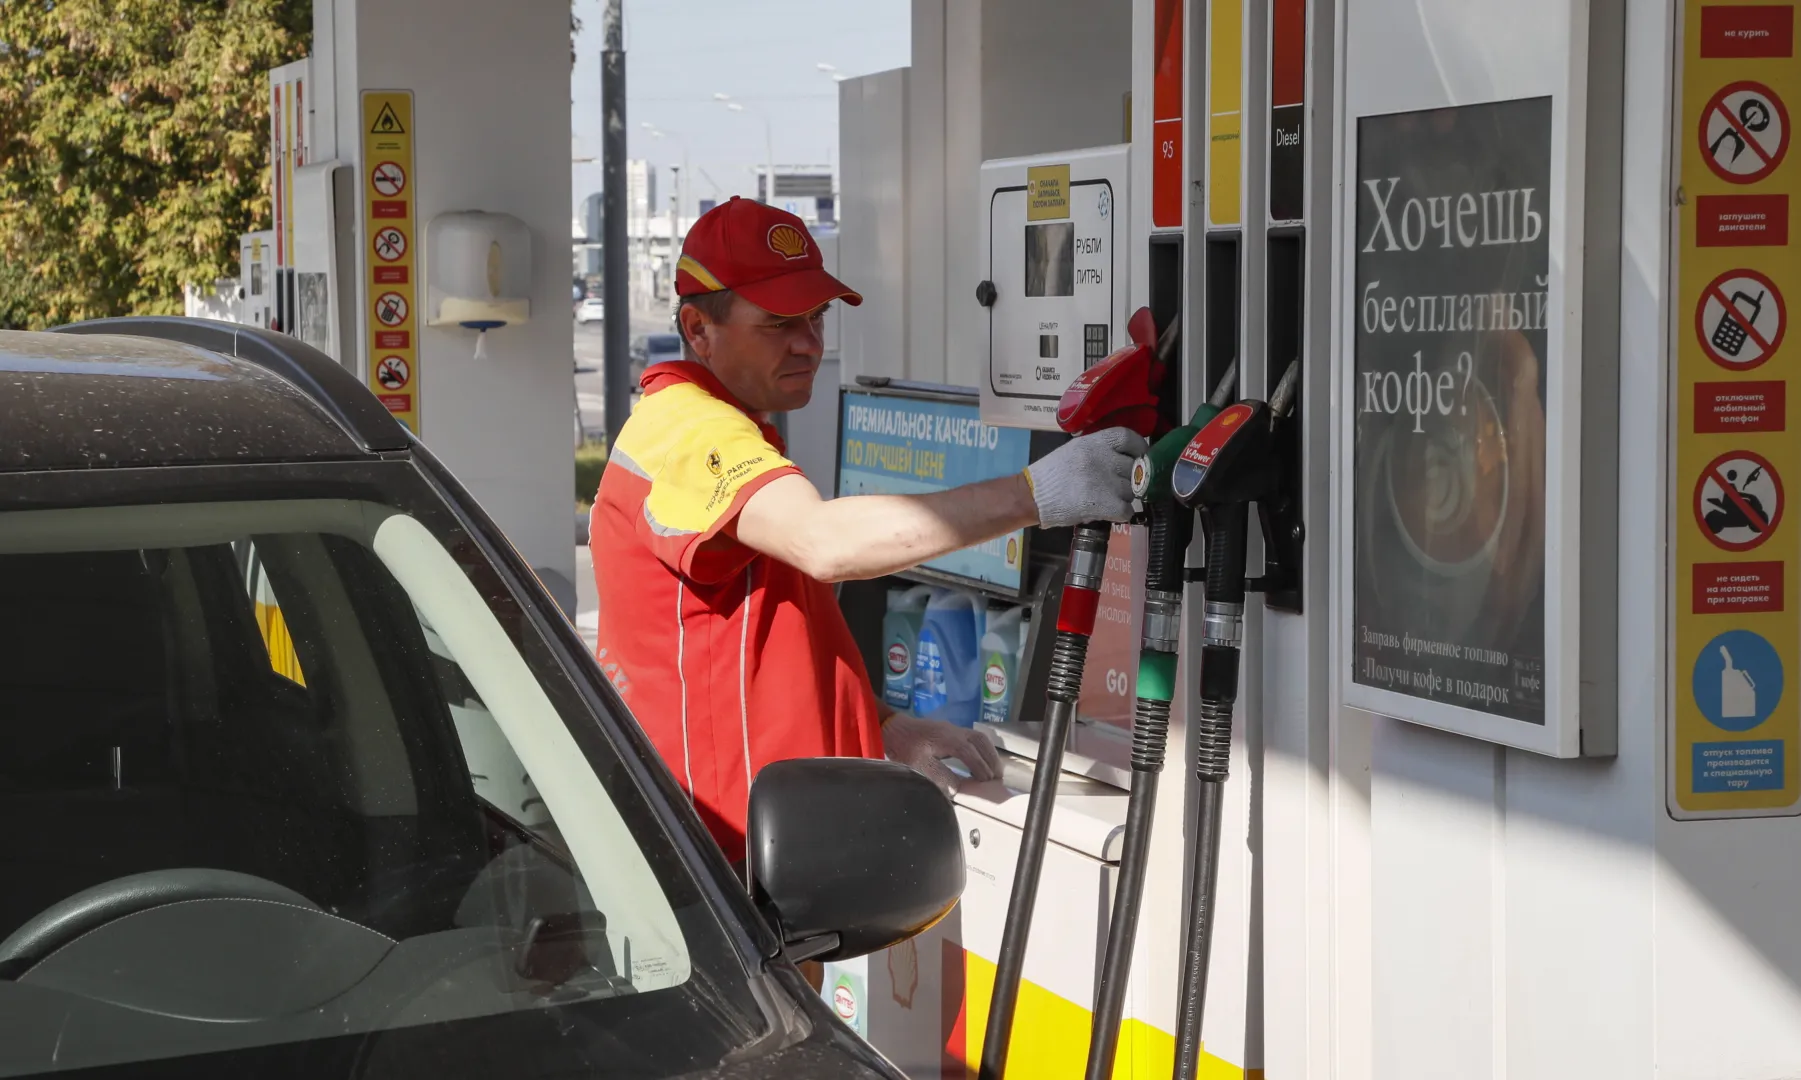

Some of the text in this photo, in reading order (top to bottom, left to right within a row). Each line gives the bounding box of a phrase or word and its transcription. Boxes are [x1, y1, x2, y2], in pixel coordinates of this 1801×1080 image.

[1738, 30, 1770, 39] курить
[1276, 124, 1300, 147] Diesel
[1162, 140, 1174, 159] 95
[1362, 177, 1543, 253] Хочешь
[1719, 213, 1767, 223] заглушите
[1718, 224, 1766, 232] двигатели
[1076, 238, 1102, 254] РУБЛИ
[1076, 269, 1103, 285] ЛИТРЫ
[1363, 275, 1549, 334] бесплатный
[1362, 350, 1473, 433] кофе?
[1715, 394, 1764, 402] отключите
[1713, 403, 1766, 413] мобильный
[1720, 414, 1759, 424] телефон
[848, 405, 999, 451] ПРЕМИАЛЬНОЕ КАЧЕСТВО
[846, 439, 946, 480] ПО ЛУЧШЕЙ ЦЕНЕ
[1184, 448, 1211, 463] V-Power
[726, 456, 765, 477] PARTNER
[1105, 556, 1132, 574] ОСТЫЕ
[1730, 575, 1760, 583] сидеть
[1111, 586, 1131, 600] SHELL
[1720, 584, 1770, 593] мотоцикле
[1707, 595, 1770, 605] при заправке
[1361, 625, 1400, 650] Заправь
[1402, 632, 1461, 658] фирменное
[1464, 646, 1509, 667] топливо
[986, 672, 1005, 686] SINTEC
[1106, 668, 1128, 697] GO
[1413, 668, 1442, 696] кофе
[1446, 678, 1453, 693] в
[1456, 679, 1510, 706] подарок
[1703, 748, 1774, 758] отпуск топлива
[1706, 759, 1770, 769] производится
[1710, 768, 1773, 778] специальную
[1726, 780, 1749, 788] тару
